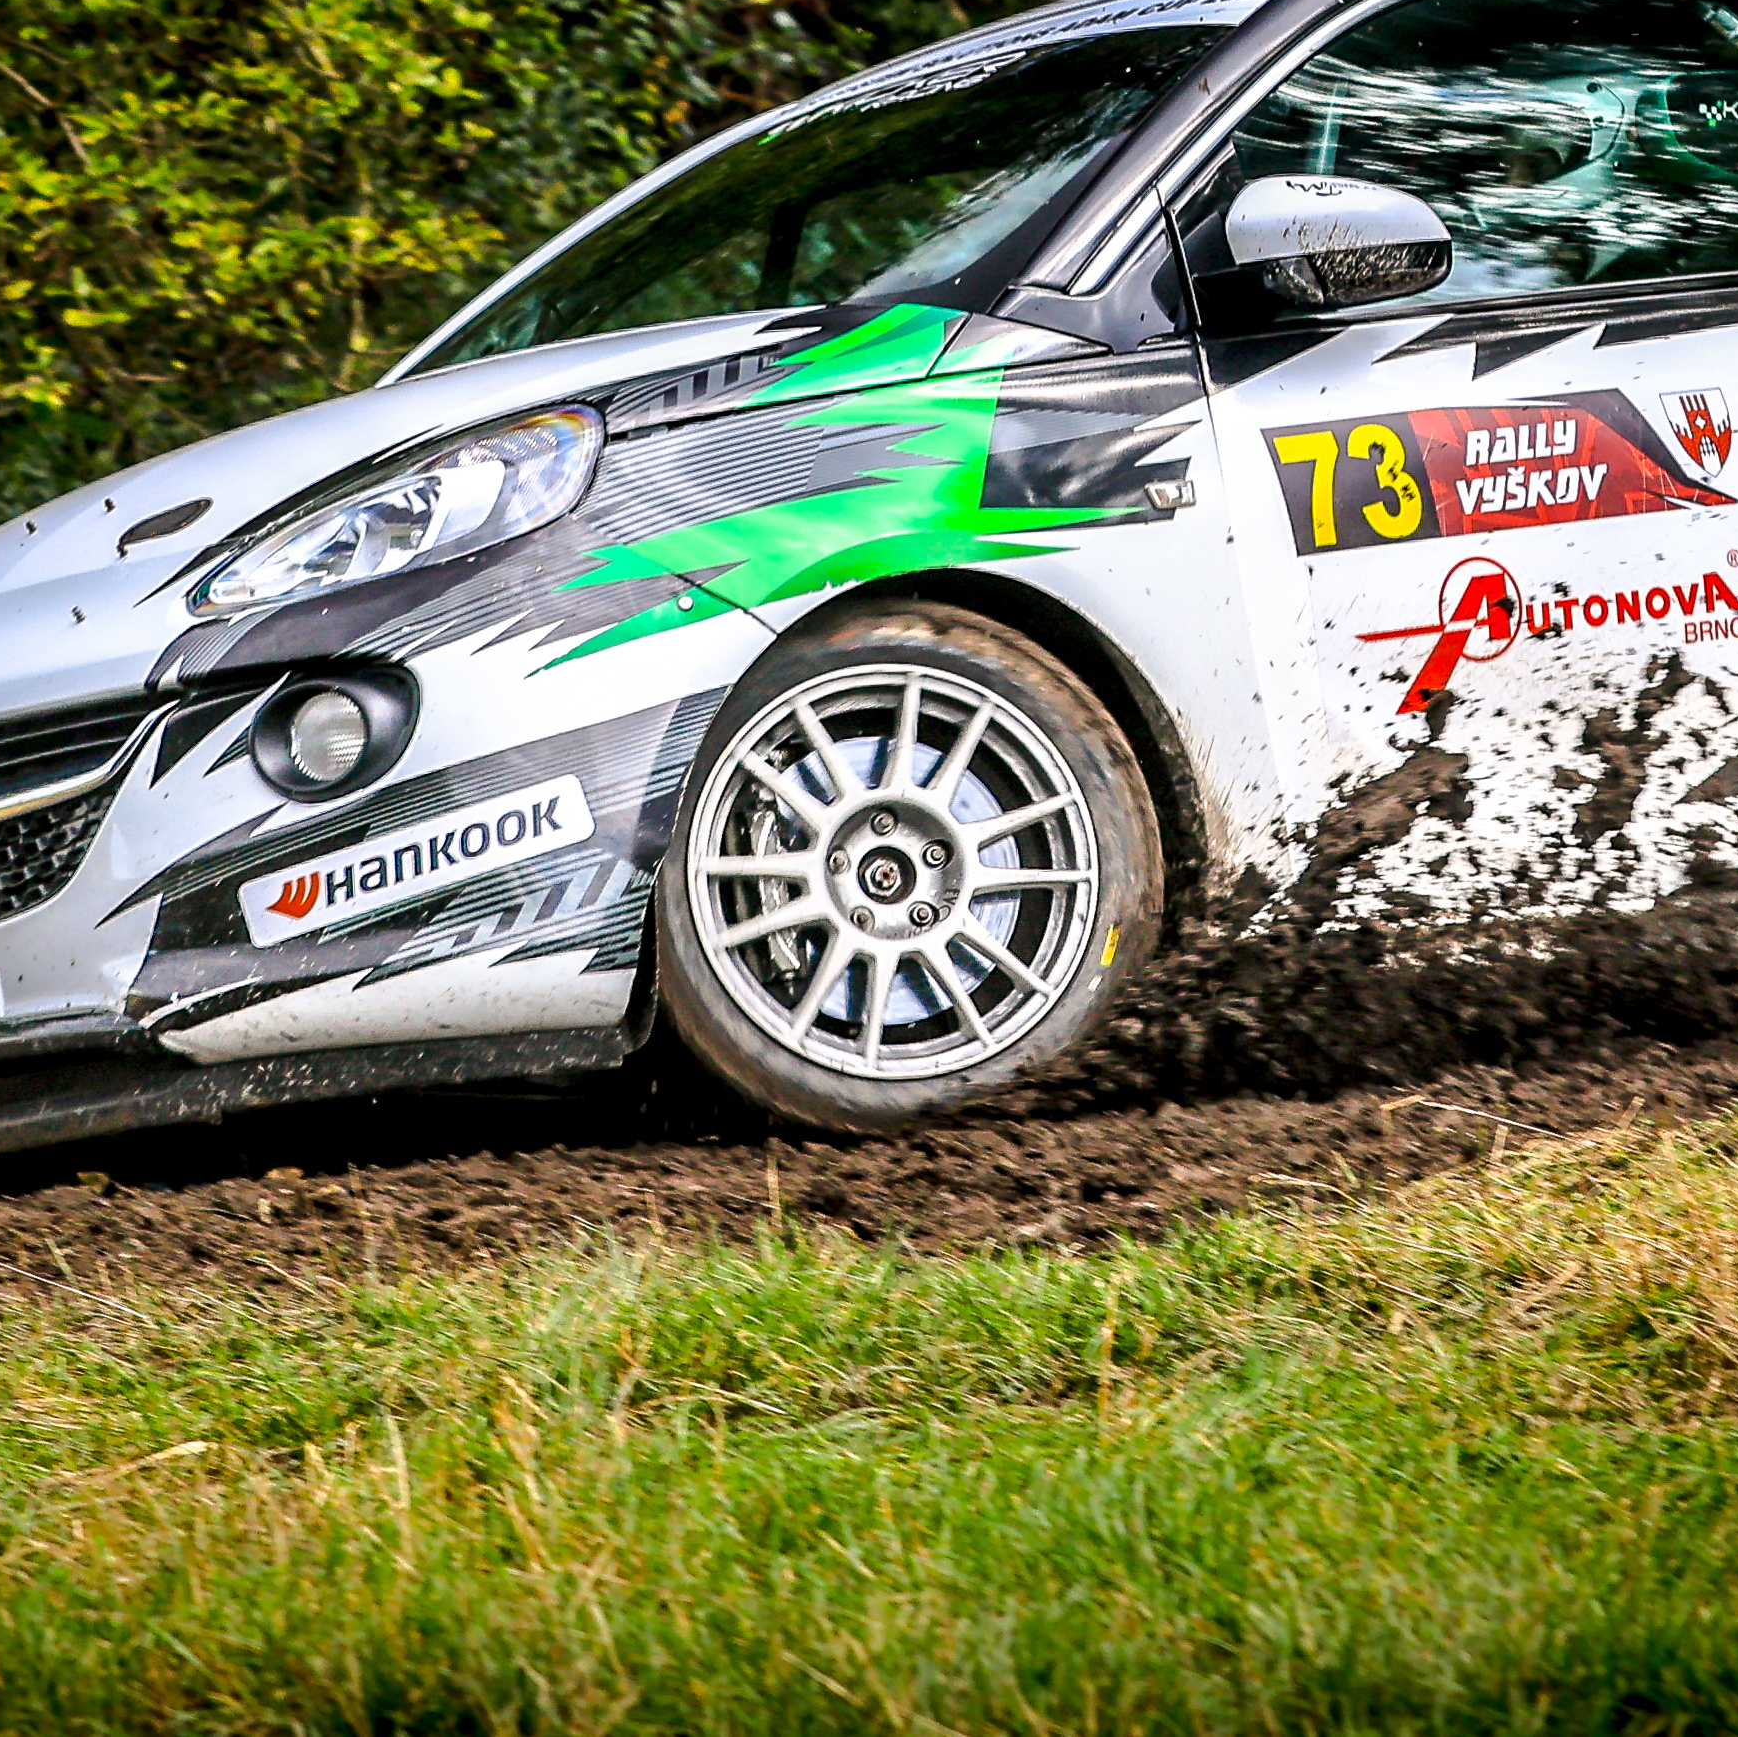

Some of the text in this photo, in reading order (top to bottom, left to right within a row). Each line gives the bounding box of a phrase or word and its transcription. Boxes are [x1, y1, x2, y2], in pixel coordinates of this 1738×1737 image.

[1466, 419, 1577, 466] RALLY
[1273, 423, 1423, 547] 73
[1455, 464, 1607, 515] VYŠKOV
